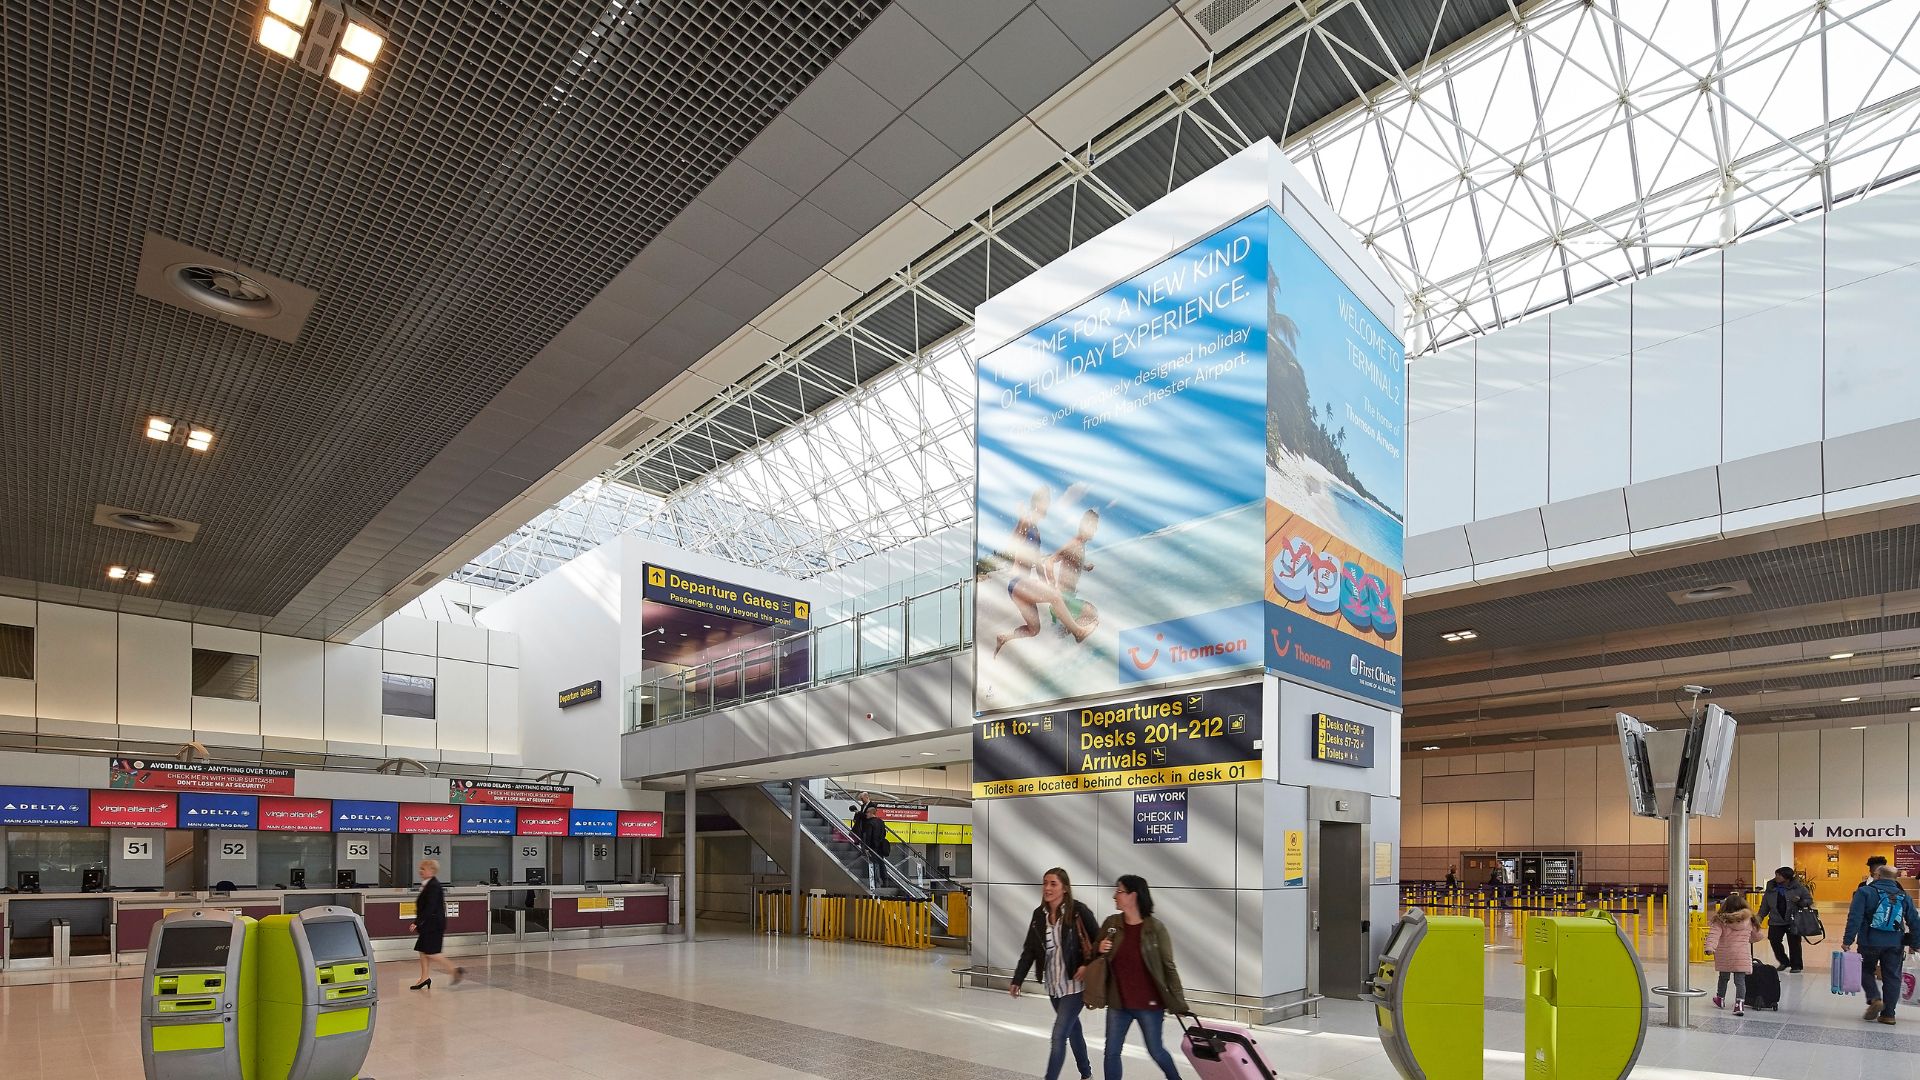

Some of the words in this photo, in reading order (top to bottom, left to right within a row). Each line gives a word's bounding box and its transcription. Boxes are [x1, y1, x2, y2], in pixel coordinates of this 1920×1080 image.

[1073, 307, 1111, 344] FOR
[1117, 297, 1131, 322] A
[1138, 265, 1186, 312] NEW
[1193, 235, 1250, 283] KIND
[1000, 382, 1023, 409] OF
[1028, 342, 1107, 398] HOLIDAY
[1112, 274, 1250, 358] EXPERIENCE.
[1337, 295, 1387, 362] WELCOME
[1387, 346, 1400, 373] TO
[1052, 402, 1077, 425] your
[1134, 347, 1194, 386] designed
[1198, 326, 1251, 358] holiday
[1345, 337, 1393, 401] TERMINAL
[1394, 385, 1400, 406] 2
[1083, 409, 1112, 431] from
[1115, 376, 1191, 416] Manchester
[1194, 351, 1250, 385] Airport.
[1363, 395, 1375, 417] The
[1376, 408, 1393, 432] home
[1345, 401, 1376, 440] Thomson
[1376, 430, 1400, 458] Airways
[670, 574, 738, 601] Departure
[743, 592, 779, 611] Gates
[670, 593, 714, 609] Passengers
[716, 604, 731, 614] only
[733, 607, 759, 619] beyond
[761, 613, 773, 622] this
[775, 617, 791, 626] point
[1169, 638, 1247, 663] Thomson
[1294, 643, 1331, 670] Thomson
[1359, 660, 1375, 679] First
[1375, 666, 1396, 687] Choice
[580, 687, 593, 697] Gates
[1081, 700, 1183, 728] Departures
[983, 721, 1006, 740] Lift
[1012, 720, 1039, 736] to:-
[1081, 729, 1136, 751] Desks
[1144, 716, 1223, 744] 201-212
[1326, 718, 1343, 732] Desks
[1344, 723, 1361, 736] 01-56
[1326, 732, 1343, 746] Desks
[1344, 737, 1360, 749] 57-73
[1081, 750, 1147, 772] Arrivals
[1326, 747, 1344, 760] Toilets
[150, 762, 173, 770] AVOID
[174, 763, 202, 771] DELAYS
[208, 765, 245, 774] ANYTHING
[983, 783, 1014, 796] Toilets
[1018, 783, 1034, 793] are
[1039, 778, 1079, 791] located
[1083, 774, 1122, 789] behind
[1127, 771, 1165, 786] check
[1171, 771, 1182, 783] in
[1188, 767, 1222, 782] desk
[1229, 765, 1245, 779] 01
[1136, 793, 1157, 803] NEW
[1159, 791, 1186, 802] YORK
[98, 805, 127, 813] virgin
[127, 805, 162, 813] atlantic
[1137, 811, 1171, 822] CHECK
[1174, 811, 1184, 821] IN
[1146, 823, 1174, 834] HERE
[1826, 824, 1906, 837] Monarch
[127, 842, 148, 854] 51
[222, 843, 244, 855] 52
[349, 844, 368, 856] 53
[423, 845, 442, 856] 54
[522, 847, 538, 857] 55
[593, 847, 608, 857] 56
[944, 851, 952, 859] 61
